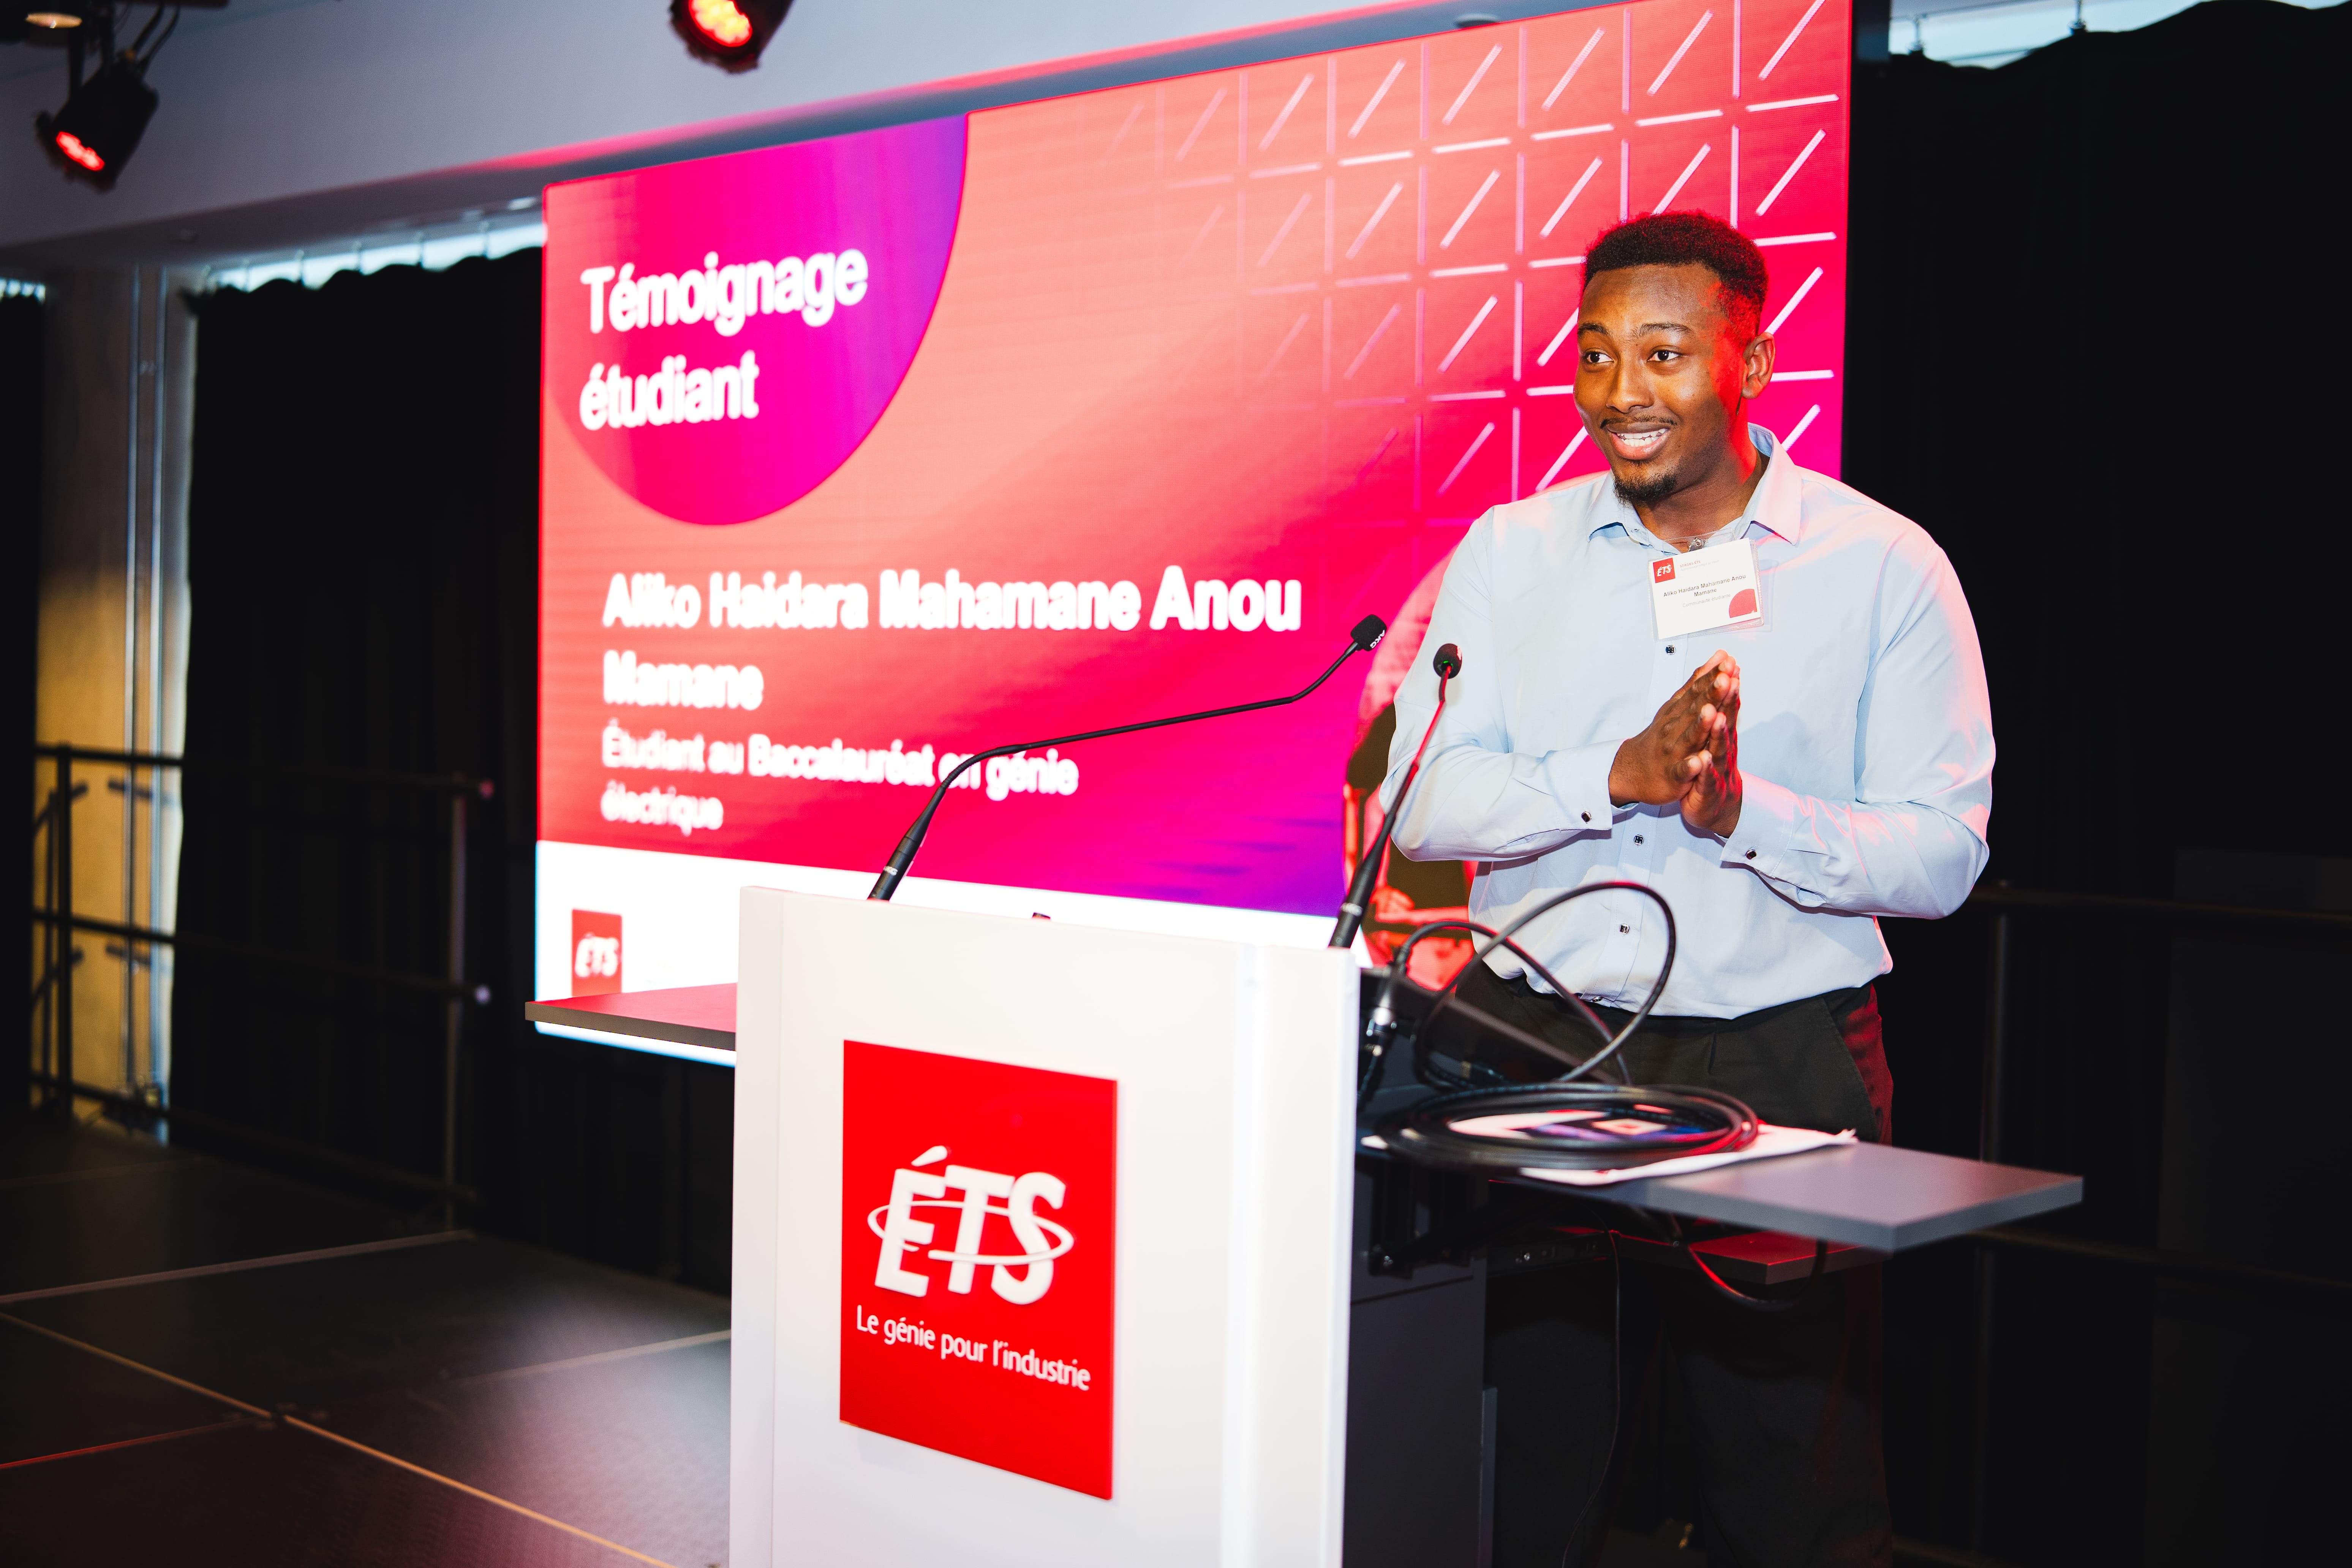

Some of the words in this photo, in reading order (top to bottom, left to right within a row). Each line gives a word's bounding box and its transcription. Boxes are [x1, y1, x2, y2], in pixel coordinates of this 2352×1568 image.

[580, 251, 868, 337] Témoignage
[579, 349, 760, 431] étudiant
[602, 572, 702, 629] Aliko
[709, 571, 869, 629] Haidara
[879, 569, 1141, 631] Mahamane
[1149, 565, 1301, 632] Anou
[1657, 564, 1672, 577] ÉTS
[1678, 585, 1699, 594] Haidara
[1701, 578, 1731, 588] Mahamane
[1694, 588, 1717, 597] Mamane
[1370, 629, 1385, 649] AKG
[603, 649, 764, 710] Mamane
[602, 717, 705, 773] Étudiant
[708, 740, 745, 775] au
[748, 733, 936, 788] Baccalauréat
[985, 746, 1080, 801] génie
[601, 779, 724, 837] électrique
[574, 931, 620, 978] ÉTS
[874, 1145, 1068, 1305] ÉTS
[857, 1305, 879, 1334] Le
[884, 1317, 936, 1350] génie
[942, 1334, 988, 1363] pour
[993, 1339, 1091, 1391] l'industrie
